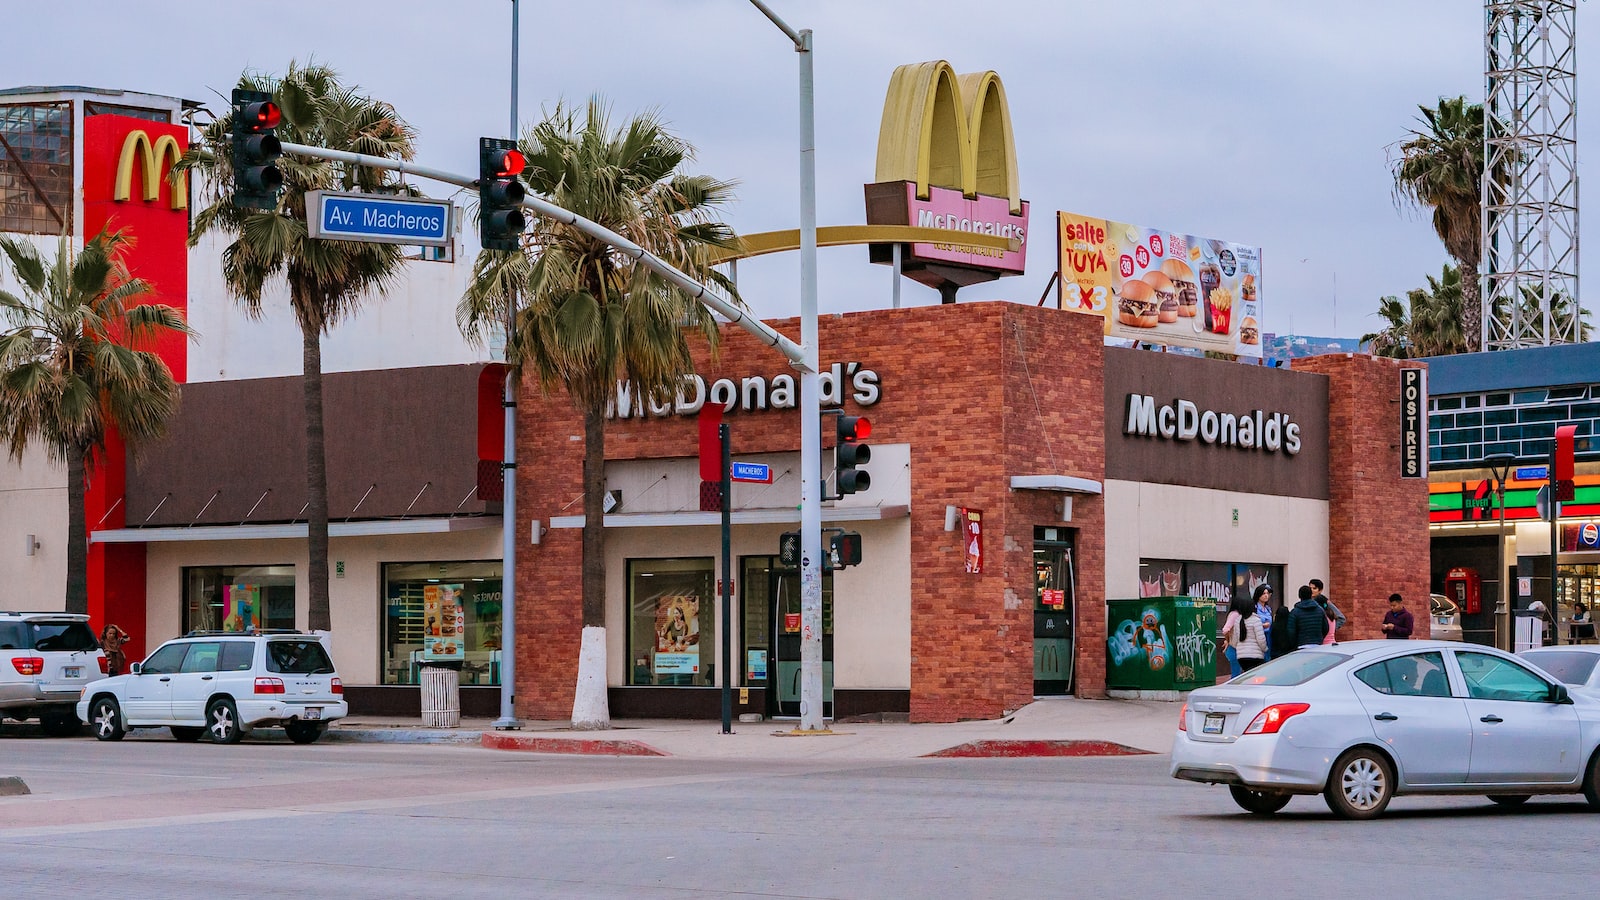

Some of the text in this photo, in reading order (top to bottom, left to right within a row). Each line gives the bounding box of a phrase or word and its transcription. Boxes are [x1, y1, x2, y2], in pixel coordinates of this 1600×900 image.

[329, 206, 440, 231] Av. Macheros
[918, 209, 1024, 246] McDonald's
[1066, 221, 1104, 245] salte
[1066, 248, 1107, 274] TUYA
[604, 362, 879, 419] McDonad's
[1125, 394, 1301, 455] McDonald's
[1406, 371, 1417, 475] POSTRES
[738, 466, 763, 476] MACHEROS
